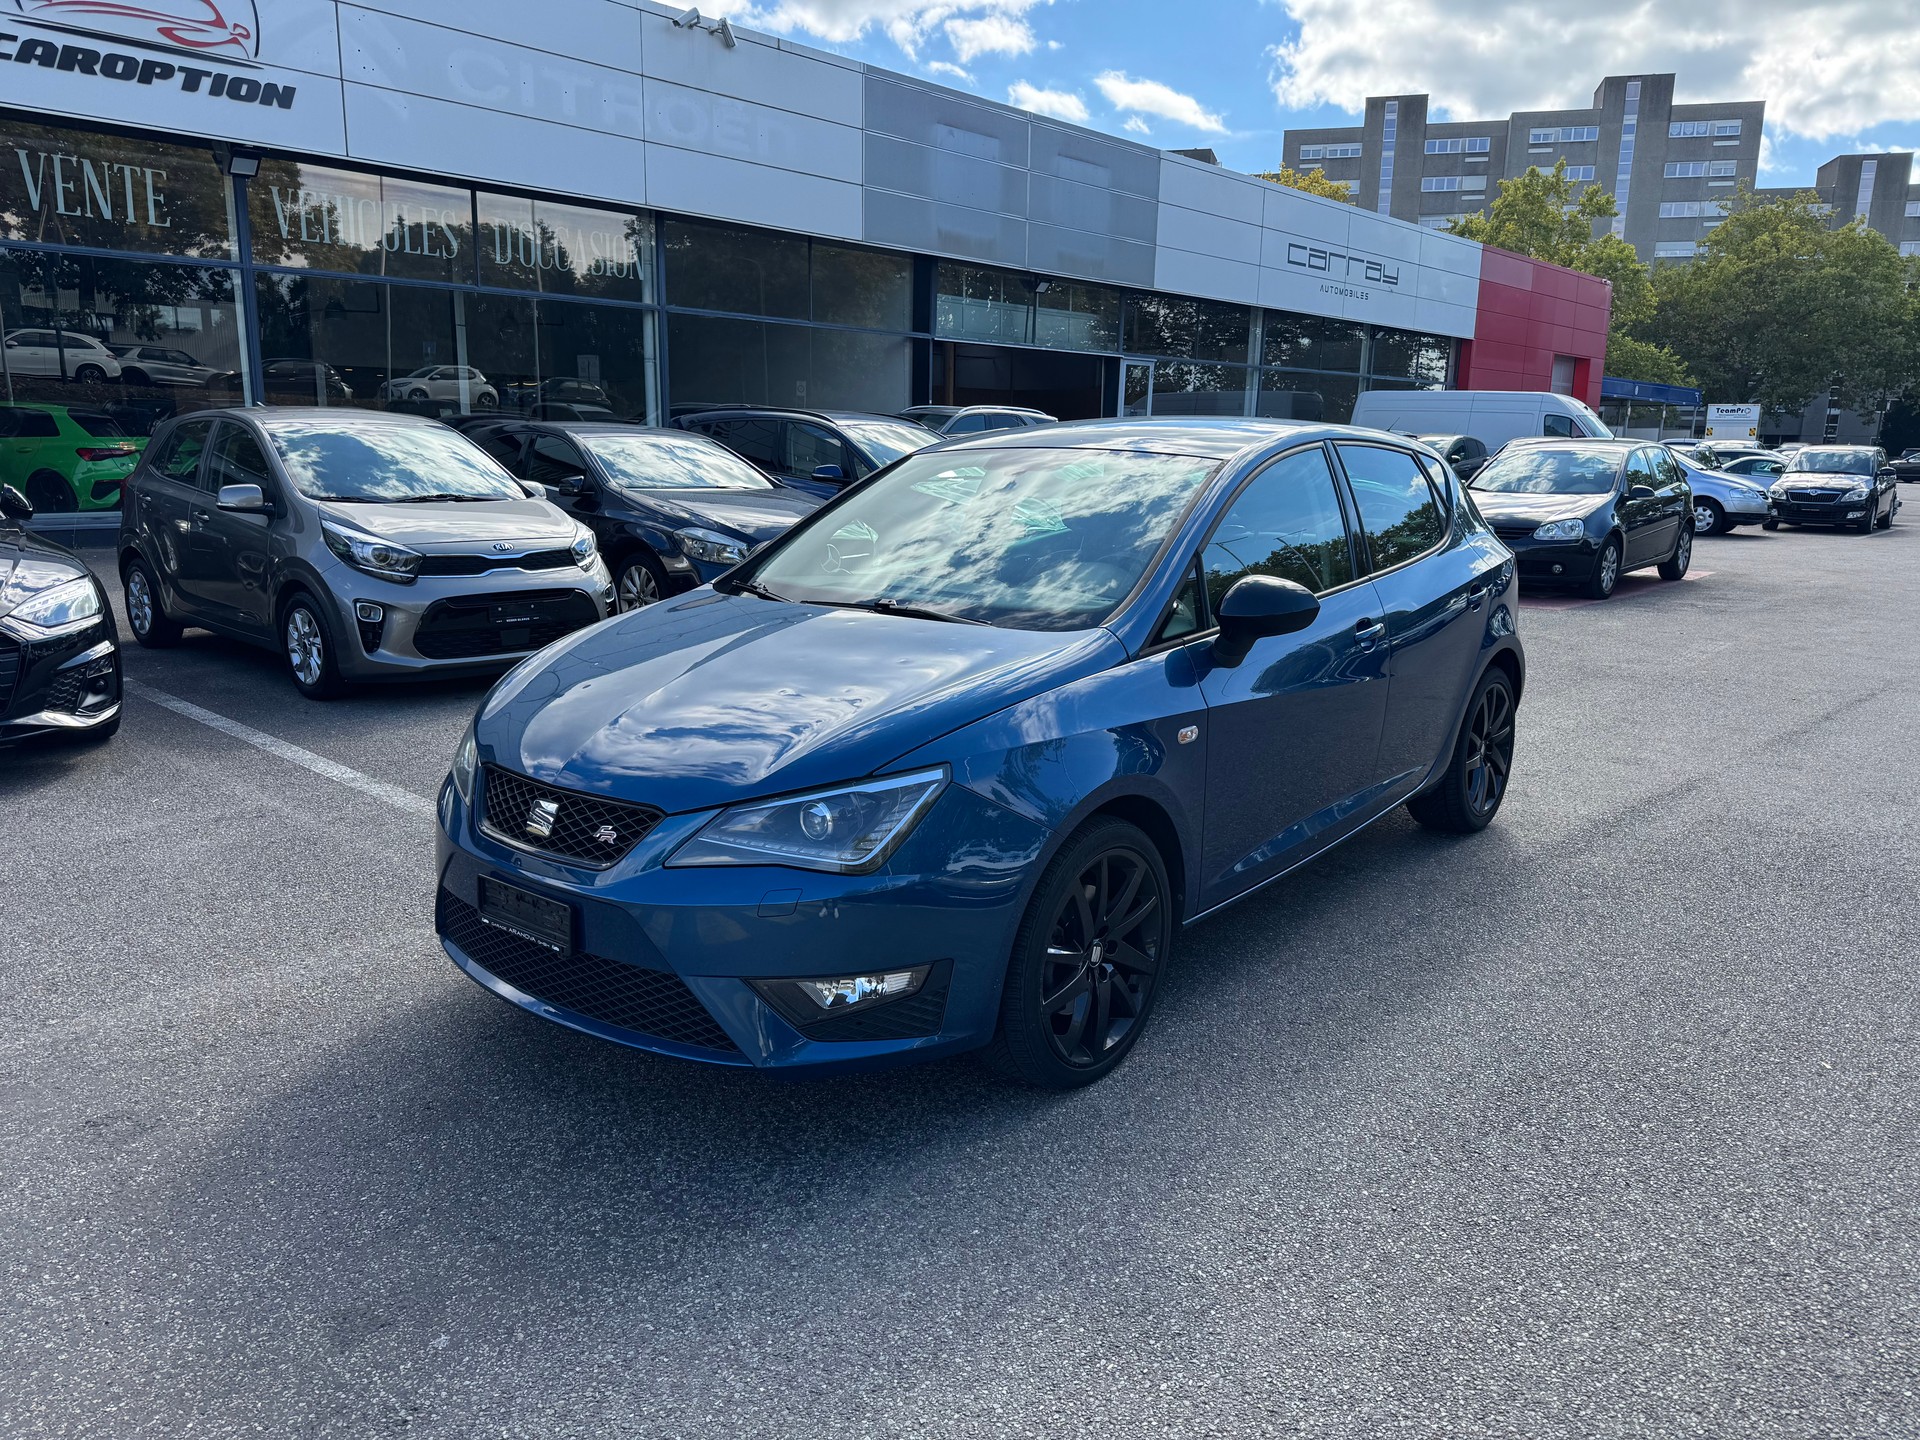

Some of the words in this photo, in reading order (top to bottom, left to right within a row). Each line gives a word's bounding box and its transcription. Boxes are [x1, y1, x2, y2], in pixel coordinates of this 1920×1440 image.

[14, 148, 172, 229] VENTE
[1288, 243, 1399, 285] carray
[1320, 285, 1369, 300] AUTOMOBILES
[494, 543, 514, 551] KIA
